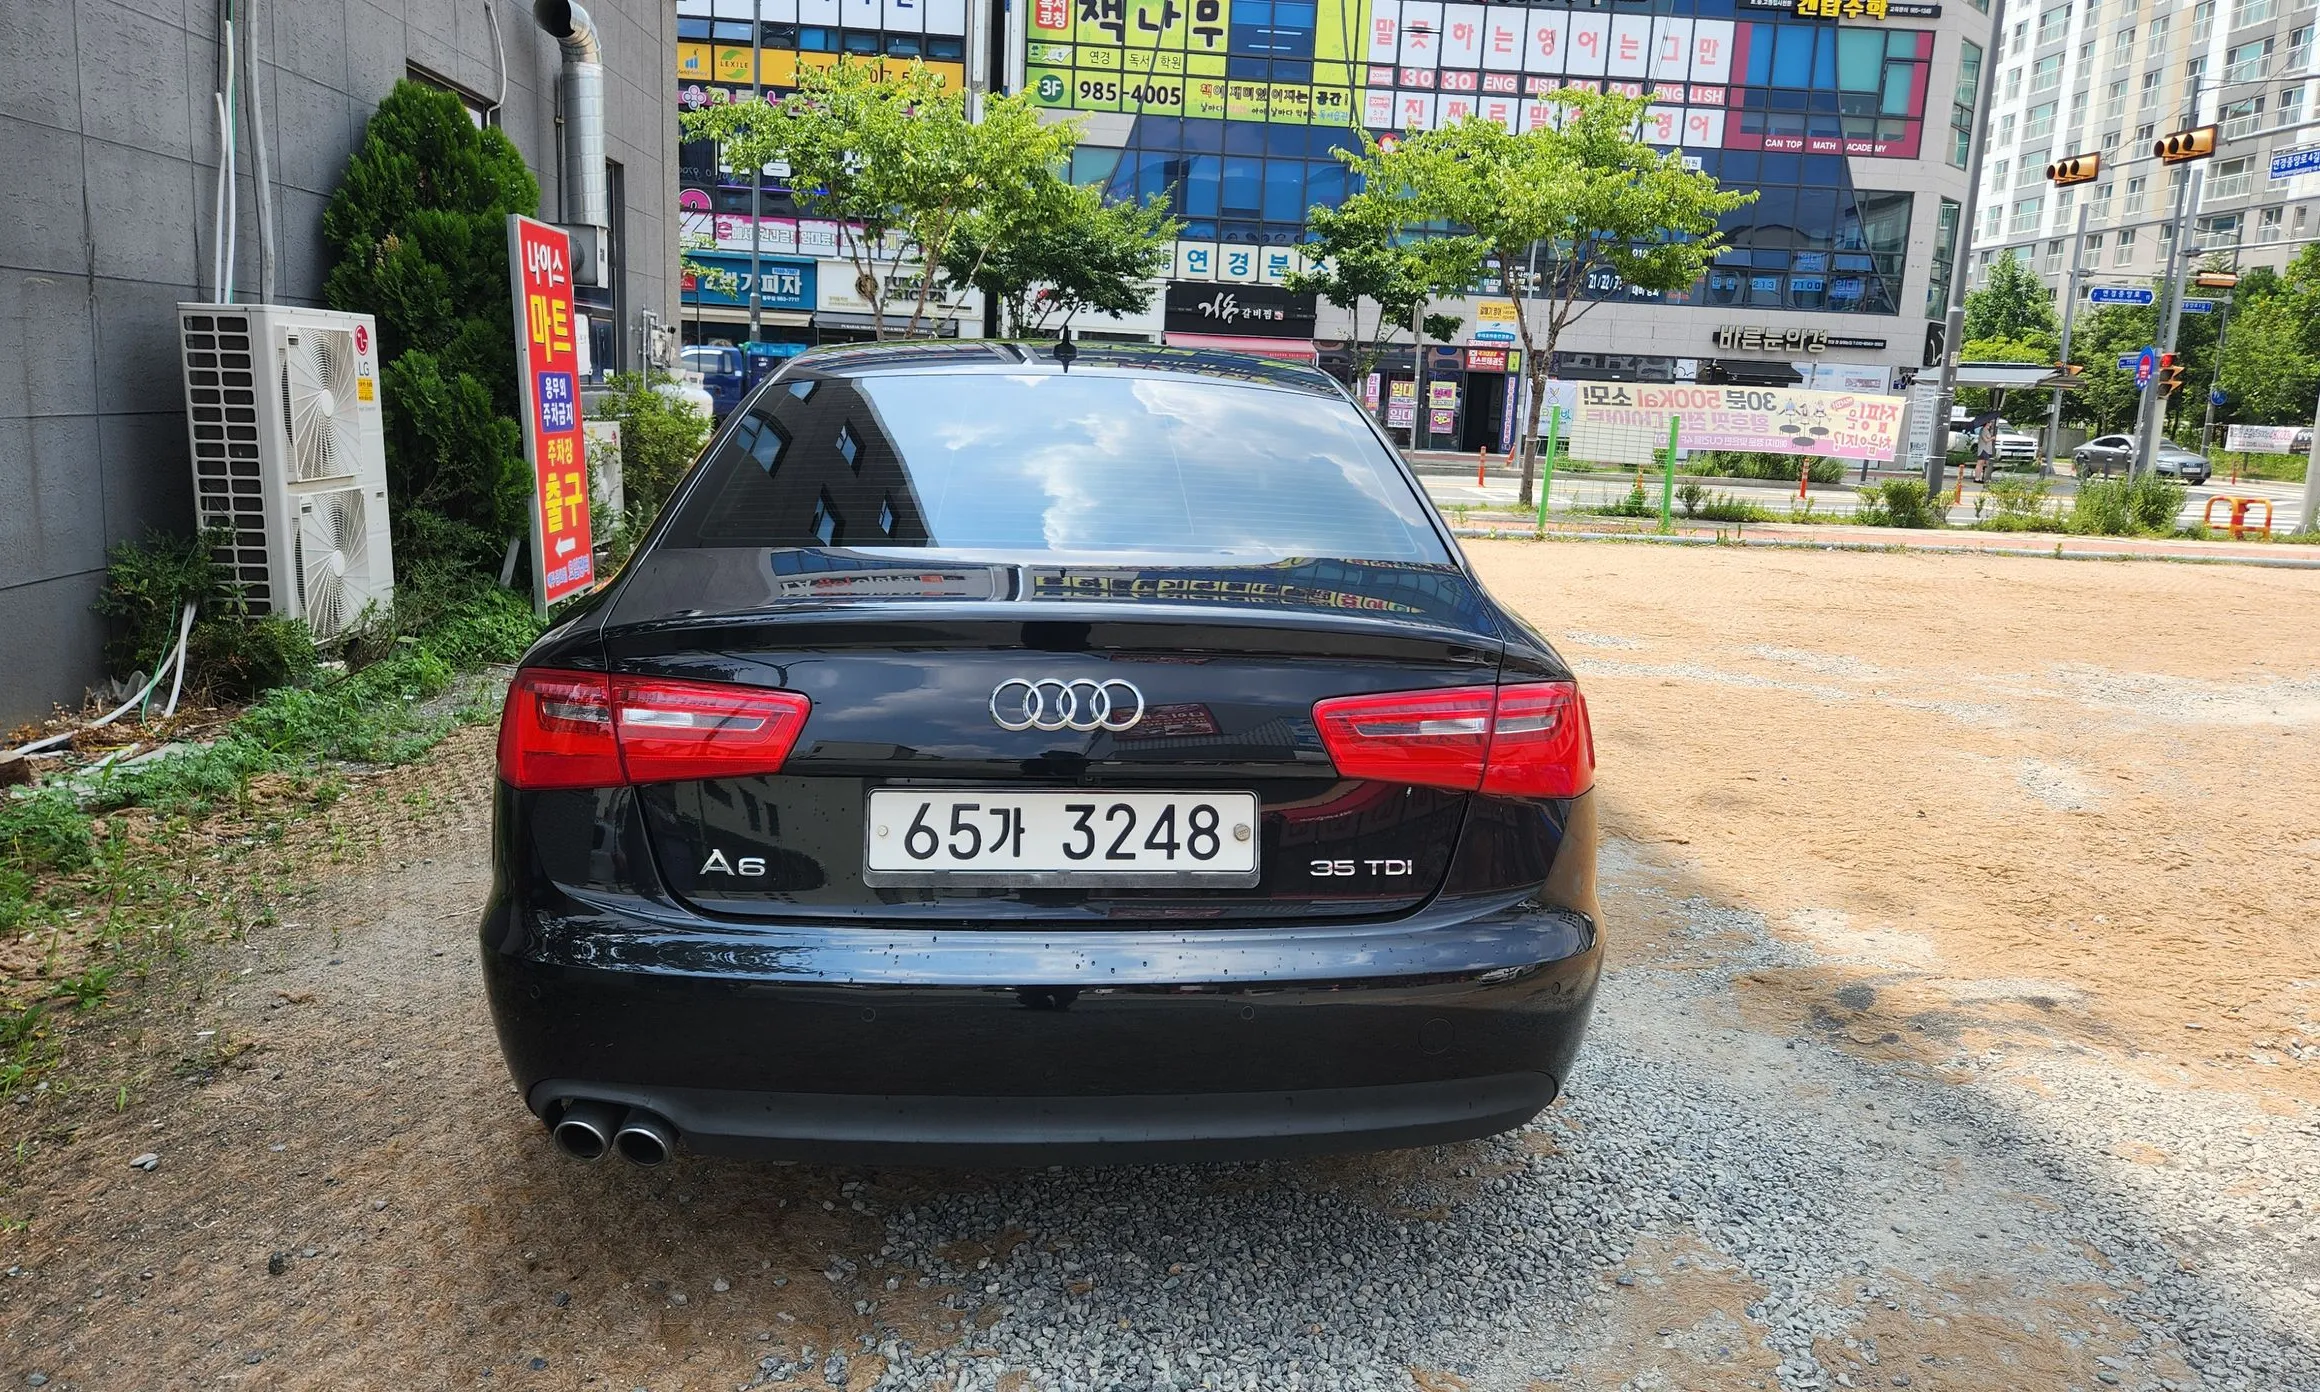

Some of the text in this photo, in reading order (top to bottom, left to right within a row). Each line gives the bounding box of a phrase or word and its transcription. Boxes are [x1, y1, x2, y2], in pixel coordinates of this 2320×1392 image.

[1038, 11, 1066, 28] 코칭
[720, 60, 748, 69] LEXILE
[1089, 51, 1181, 70] 연경 독서 학원
[1041, 80, 1062, 96] 3F
[1079, 81, 1181, 105] 985-4005
[1765, 138, 1887, 153] CAN TOP MATH ACADEMY
[527, 240, 565, 287] 나이스
[1241, 308, 1272, 321] 갈비찜
[530, 294, 572, 362] 마트
[1718, 325, 1829, 354] 바른눈안경
[358, 361, 370, 377] LG
[545, 375, 567, 400] 용무외
[1392, 382, 1415, 397] 임대
[543, 400, 574, 432] 주차금지
[1390, 408, 1413, 420] 임대
[547, 436, 574, 466] 주차장
[544, 472, 584, 534] 출구
[903, 802, 1222, 862] 65가 3248
[700, 848, 766, 877] A6
[1309, 859, 1413, 876] 35 TDI
